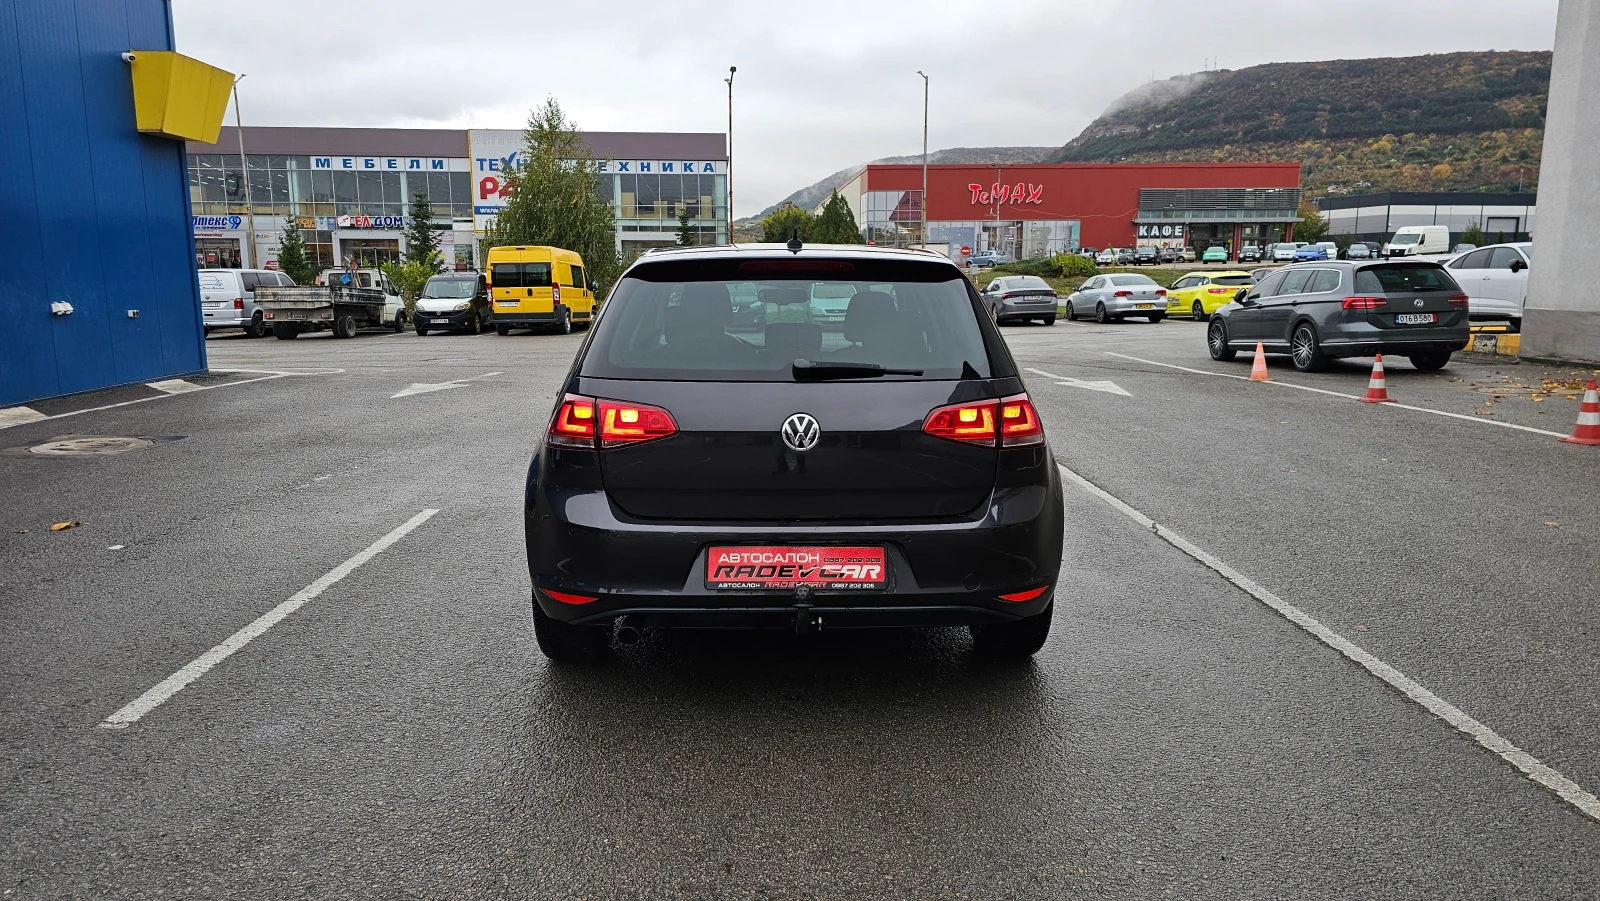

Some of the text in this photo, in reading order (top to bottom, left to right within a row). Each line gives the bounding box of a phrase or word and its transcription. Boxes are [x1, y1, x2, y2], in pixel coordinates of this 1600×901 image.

[315, 158, 444, 169] МЕБЕЛИ
[597, 161, 714, 172] ЕХНИКА
[354, 215, 404, 228] ЕЛ ДОМ
[1138, 225, 1183, 237] КАФЕ
[718, 552, 820, 564] АВТОСАЛОН
